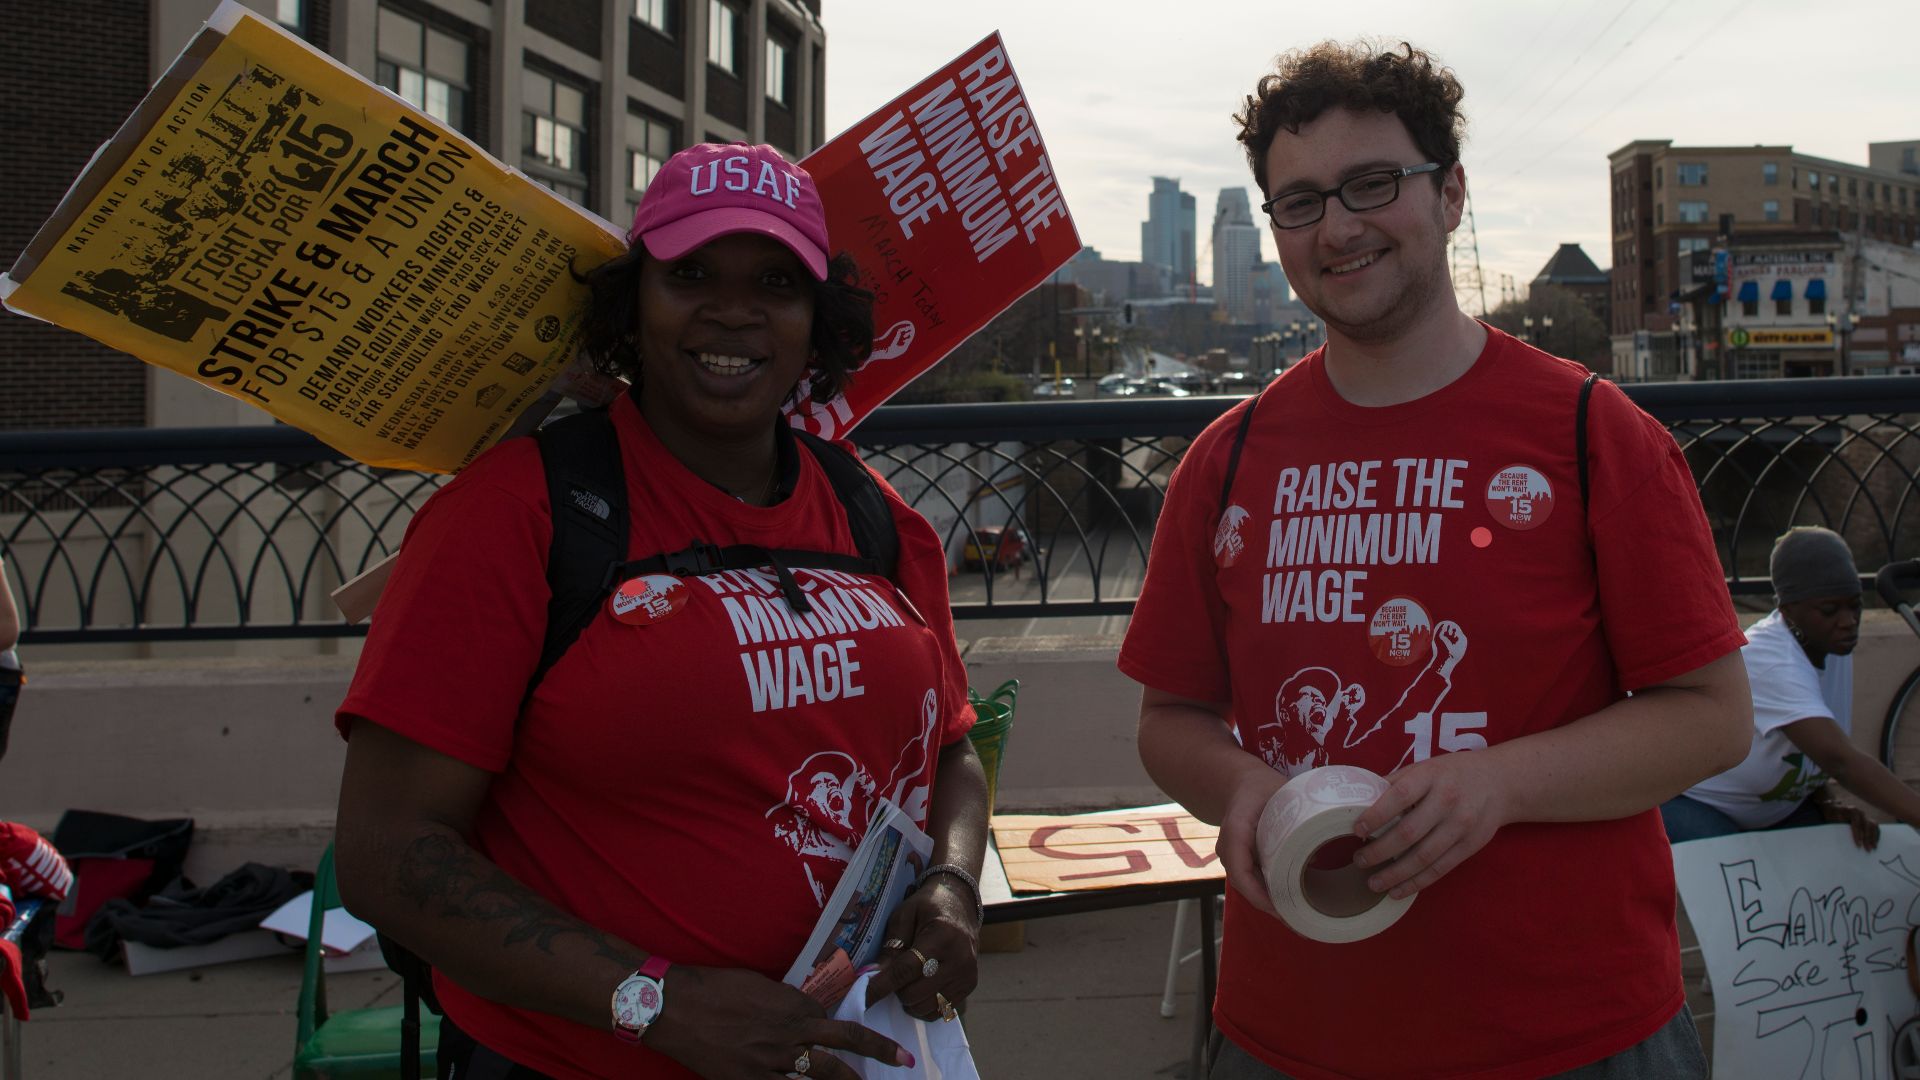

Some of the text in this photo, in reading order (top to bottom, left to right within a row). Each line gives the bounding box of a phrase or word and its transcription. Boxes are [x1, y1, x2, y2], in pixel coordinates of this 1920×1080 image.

[67, 83, 212, 253] NATIONAL DAY OF ACTION
[690, 155, 801, 210] USAF
[858, 110, 949, 240] WAGE
[908, 78, 1019, 263] MINIMUM
[958, 45, 1067, 244] RAISE THE
[181, 220, 255, 292] FIGHT
[237, 179, 287, 226] FOR
[198, 116, 440, 385] STRIKE & MARCH
[213, 194, 313, 306] LUCHA POR
[241, 142, 473, 403] FOR $15 & A UNION
[858, 213, 947, 331] MARCH Today
[299, 188, 485, 401] DEMAND WORKERS RIGHTS &
[320, 201, 502, 412] RACIAL EQUITY IN MINNEAPOLIS
[340, 369, 387, 418] $15/HOUR
[381, 325, 424, 370] MINIMUM
[418, 296, 447, 325] WAGE
[450, 263, 475, 287] PAID
[470, 238, 494, 263] SICK
[489, 211, 514, 239] DAYS
[353, 400, 385, 428] FAIR
[378, 328, 444, 399] SCHEDULING
[445, 294, 472, 320] END
[466, 257, 501, 293] WAGE
[494, 216, 528, 256] THEFT
[376, 379, 432, 438] WEDNESDAY
[429, 350, 459, 378] APRIL
[455, 321, 483, 346] 15TH
[488, 284, 511, 309] 4:30
[513, 248, 537, 275] 6:00
[532, 229, 550, 247] PM
[391, 412, 425, 444] RALLY:
[421, 359, 465, 409] NORTHROP
[490, 271, 539, 331] UNIVERSITY
[535, 256, 549, 271] OF
[545, 237, 563, 256] MN
[404, 408, 446, 450] MARCH
[440, 390, 460, 405] TO
[455, 318, 520, 388] DINKYTOWN
[514, 245, 577, 320] MCDONALDS
[1273, 458, 1468, 515] RAISE THE
[1499, 472, 1528, 480] BECAUSE
[1510, 497, 1532, 514] 15
[1510, 513, 1532, 521] NOW
[1266, 512, 1442, 568] MINIMUM
[616, 590, 655, 609] WON'T WAIT
[643, 597, 669, 614] 15
[649, 604, 673, 619] NOW
[721, 586, 905, 646] MINIMUM
[1262, 569, 1368, 624] WAGE
[1381, 605, 1407, 613] BECAUSE
[1389, 633, 1411, 649] 15
[740, 639, 865, 713] WAGE
[1389, 649, 1411, 657] NOW
[1733, 960, 1828, 1007] Safe
